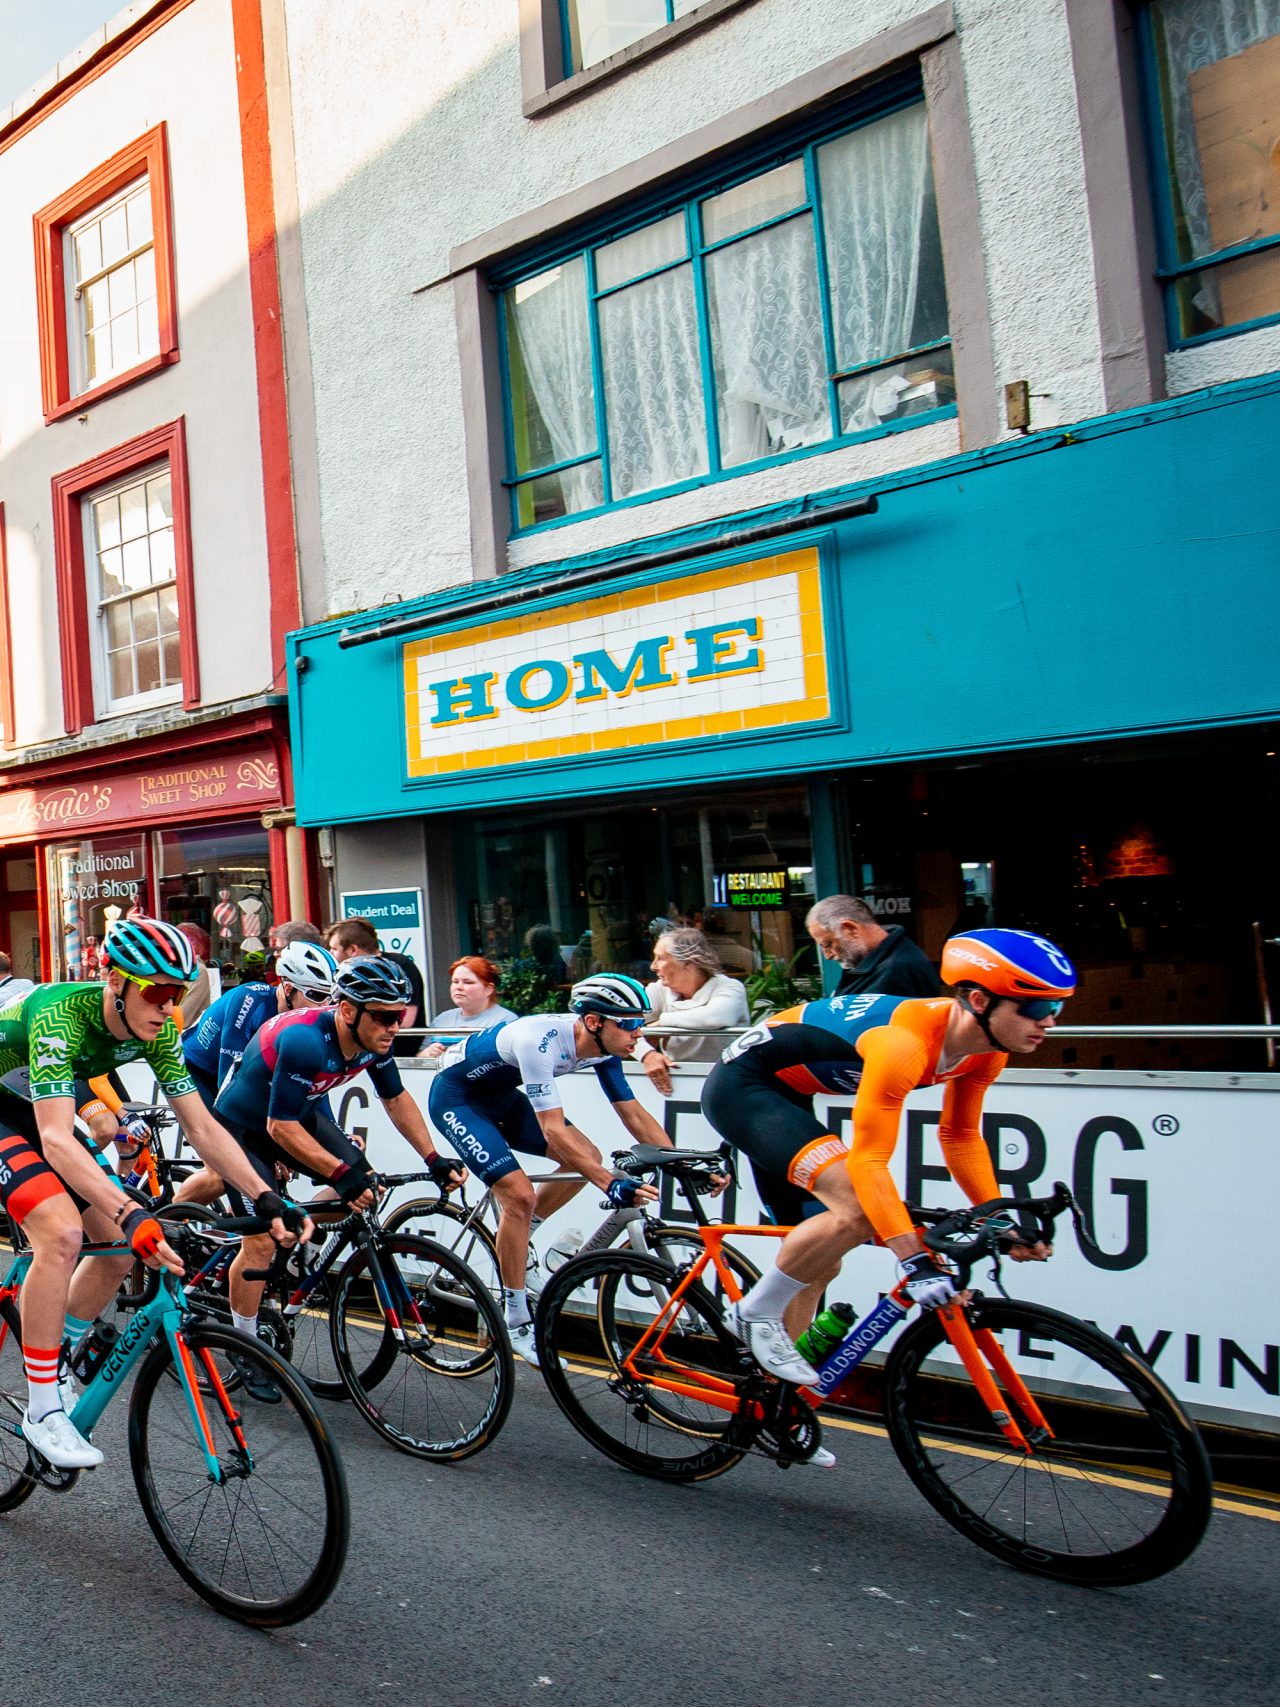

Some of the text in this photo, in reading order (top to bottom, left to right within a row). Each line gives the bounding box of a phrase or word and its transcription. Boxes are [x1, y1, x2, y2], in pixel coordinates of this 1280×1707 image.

[428, 616, 763, 729] HOME
[11, 782, 112, 829] Isaac's
[727, 871, 785, 891] RESTAURANT
[347, 903, 427, 919] Student Deal
[730, 892, 783, 906] WELCOME
[234, 994, 256, 1029] MAXXIS
[197, 1016, 221, 1050] EISBERG
[466, 1060, 507, 1080] STORCK
[445, 1128, 469, 1158] CYCLING
[461, 1134, 490, 1163] PRO
[486, 1155, 512, 1172] MARTIN
[101, 1310, 150, 1383] GENESIS
[814, 1304, 900, 1391] HOLDSWORTH
